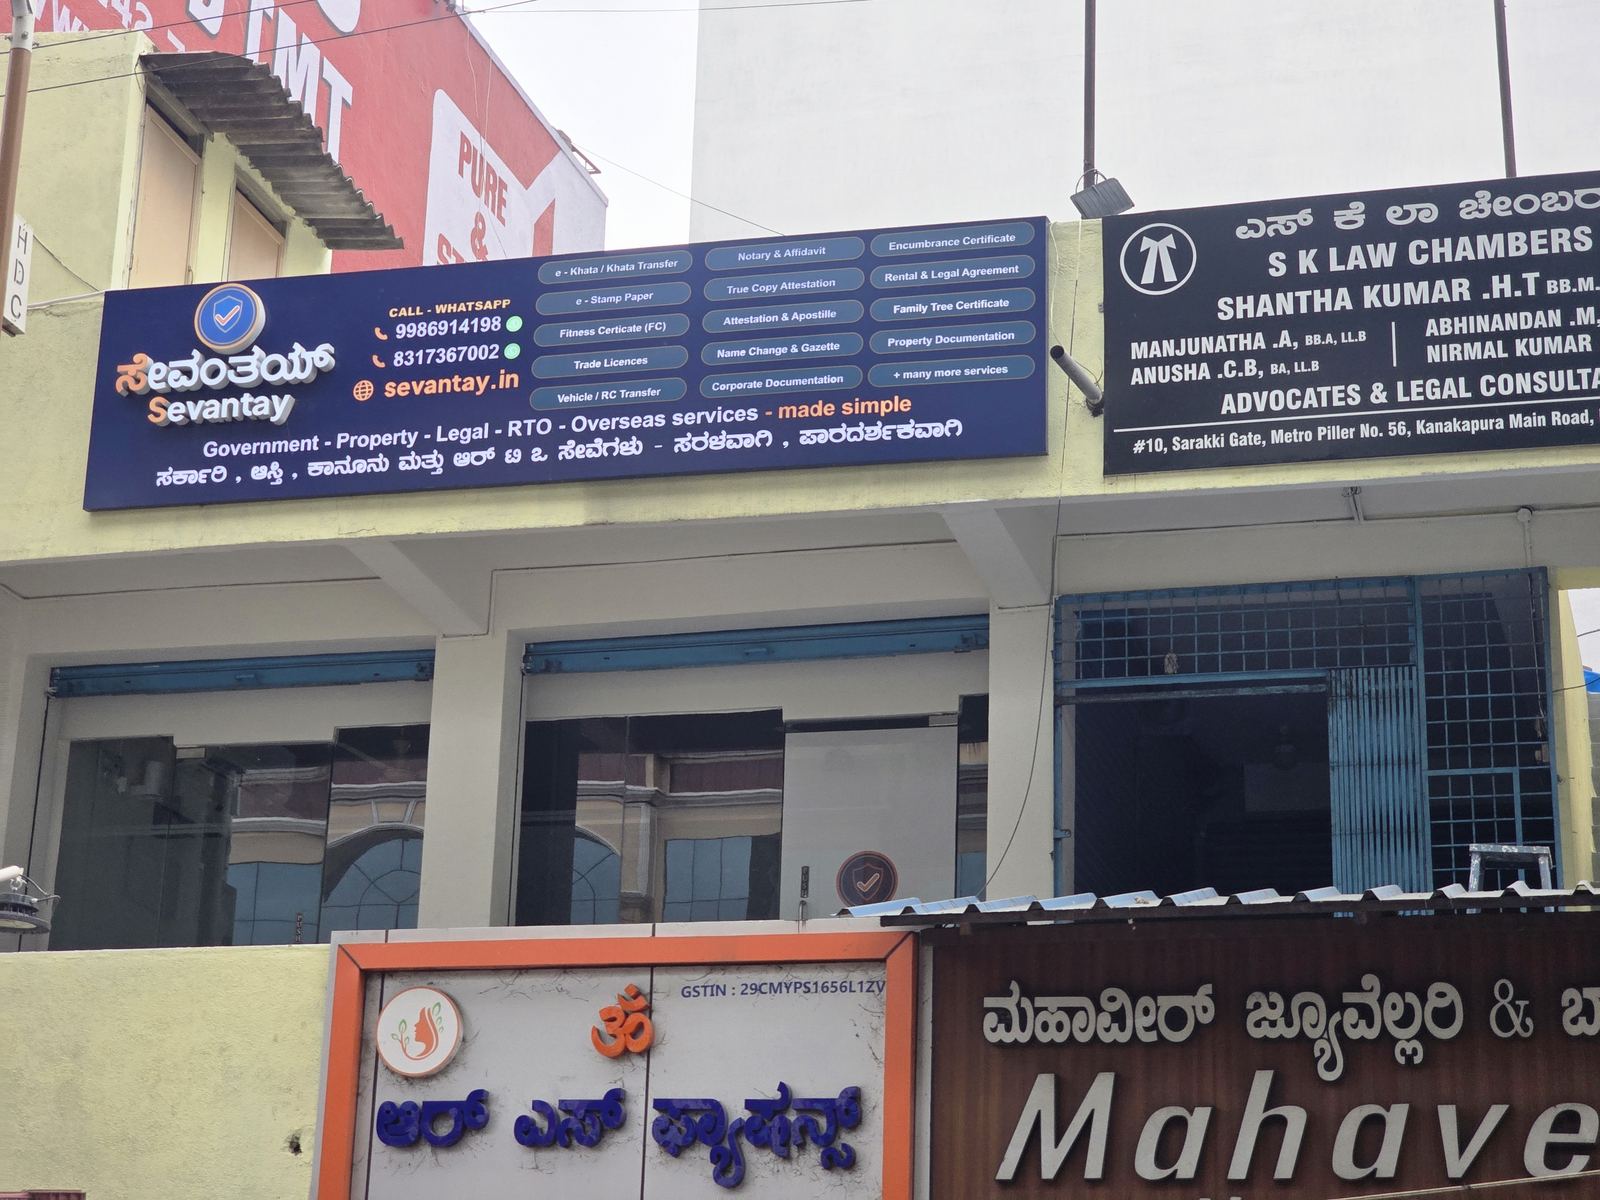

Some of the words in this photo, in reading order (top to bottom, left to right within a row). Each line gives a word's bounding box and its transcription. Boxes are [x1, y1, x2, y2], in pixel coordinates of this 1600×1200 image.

[458, 130, 508, 228] PURE
[1235, 207, 1314, 240] ಎಸ್
[1333, 201, 1366, 230] ಕೆ
[1385, 202, 1439, 226] ಲಾ
[738, 250, 771, 261] Notary
[774, 250, 781, 258] &
[784, 246, 826, 258] Affidavit
[889, 238, 960, 251] Encumbrance
[962, 233, 1016, 245] Certificate
[1268, 251, 1287, 278] S
[1298, 249, 1318, 275] K
[1329, 242, 1398, 272] LAW
[1408, 225, 1593, 266] CHAMBERS
[570, 265, 599, 276] Khata
[606, 262, 635, 273] Khata
[637, 259, 678, 271] Transfer
[885, 271, 918, 282] Rental
[920, 270, 929, 279] &
[931, 268, 960, 281] Legal
[961, 264, 1020, 278] Agreement
[591, 293, 622, 305] Stamp
[624, 291, 654, 303] Paper
[727, 285, 749, 295] True
[751, 283, 778, 294] Copy
[780, 279, 836, 291] Attestation
[389, 306, 424, 318] CALL
[435, 299, 511, 315] WHATSAPP
[893, 303, 928, 315] Family
[930, 301, 953, 311] Tree
[955, 298, 1009, 310] Certificate
[1217, 286, 1353, 322] SHANTHA
[1363, 277, 1471, 309] KUMAR
[395, 315, 502, 339] 9986914198
[559, 326, 595, 338] Fitness
[598, 324, 642, 335] Certicate
[644, 321, 667, 333] (FC)
[723, 313, 778, 326] Attestation
[781, 313, 790, 322] &
[791, 309, 837, 322] Apostille
[1425, 309, 1562, 337] ABHINANDAN
[717, 348, 746, 359] Name
[748, 346, 788, 358] Change
[790, 344, 799, 353] &
[801, 341, 840, 353] Gazette
[887, 335, 933, 348] Property
[935, 331, 1015, 344] Documentation
[1130, 332, 1266, 360] MANJUNATHA
[1305, 333, 1338, 346] BB.A,
[1341, 331, 1367, 343] LL.B
[1427, 340, 1508, 363] NIRMAL
[1515, 334, 1593, 357] KUMAR
[393, 343, 500, 367] 8317367002
[573, 359, 601, 370] Trade
[604, 356, 648, 368] Licences
[384, 369, 519, 398] sevantay.in
[712, 380, 763, 392] Corporate
[765, 374, 844, 388] Documentation
[903, 369, 932, 381] many
[934, 368, 962, 378] more
[964, 365, 1009, 376] services
[1130, 362, 1211, 386] ANUSHA
[1270, 363, 1290, 376] BA,
[1294, 361, 1320, 373] LL.B
[557, 392, 593, 403] Vehicle
[601, 389, 617, 400] RC
[619, 387, 661, 399] Transfer
[1220, 383, 1361, 415] ADVOCATES
[1370, 382, 1388, 404] &
[1396, 376, 1472, 403] LEGAL
[148, 392, 295, 426] Sevantay
[203, 434, 320, 458] Government
[336, 428, 419, 451] Property
[436, 422, 489, 444] Legal
[508, 418, 552, 438] RTO
[571, 412, 666, 433] Overseas
[672, 405, 759, 426] services
[777, 400, 836, 419] made
[841, 395, 912, 417] simple
[1133, 437, 1168, 454] #10,
[1172, 433, 1225, 451] Sarakki
[1229, 431, 1266, 448] Gate,
[1271, 428, 1313, 444] Metro
[1317, 425, 1356, 441] Piller
[1360, 422, 1383, 438] No.
[1388, 421, 1412, 438] 56,
[1416, 416, 1505, 435] Kanakapura
[1509, 411, 1546, 429] Main
[1551, 409, 1594, 427] Road,
[250, 460, 284, 486] ಆಸ್ತಿ
[307, 452, 390, 477] ಕಾನೂನು
[398, 449, 444, 475] ಮತ್ತು
[452, 446, 496, 467] ಆರ್
[558, 435, 643, 461] ಸೇವೆಗಳು
[673, 428, 773, 454] ಸರಳವಾಗಿ
[799, 417, 963, 446] ಪಾರದರ್ಶಕವಾಗಿ
[681, 984, 727, 998] GSTIN
[983, 980, 1215, 1044] ಮಹಾವೀರ್
[1489, 978, 1534, 1037] &
[376, 1088, 490, 1147] ಆರ್
[514, 1087, 627, 1148] ಎಸ್
[995, 1069, 1600, 1181] Mahave
